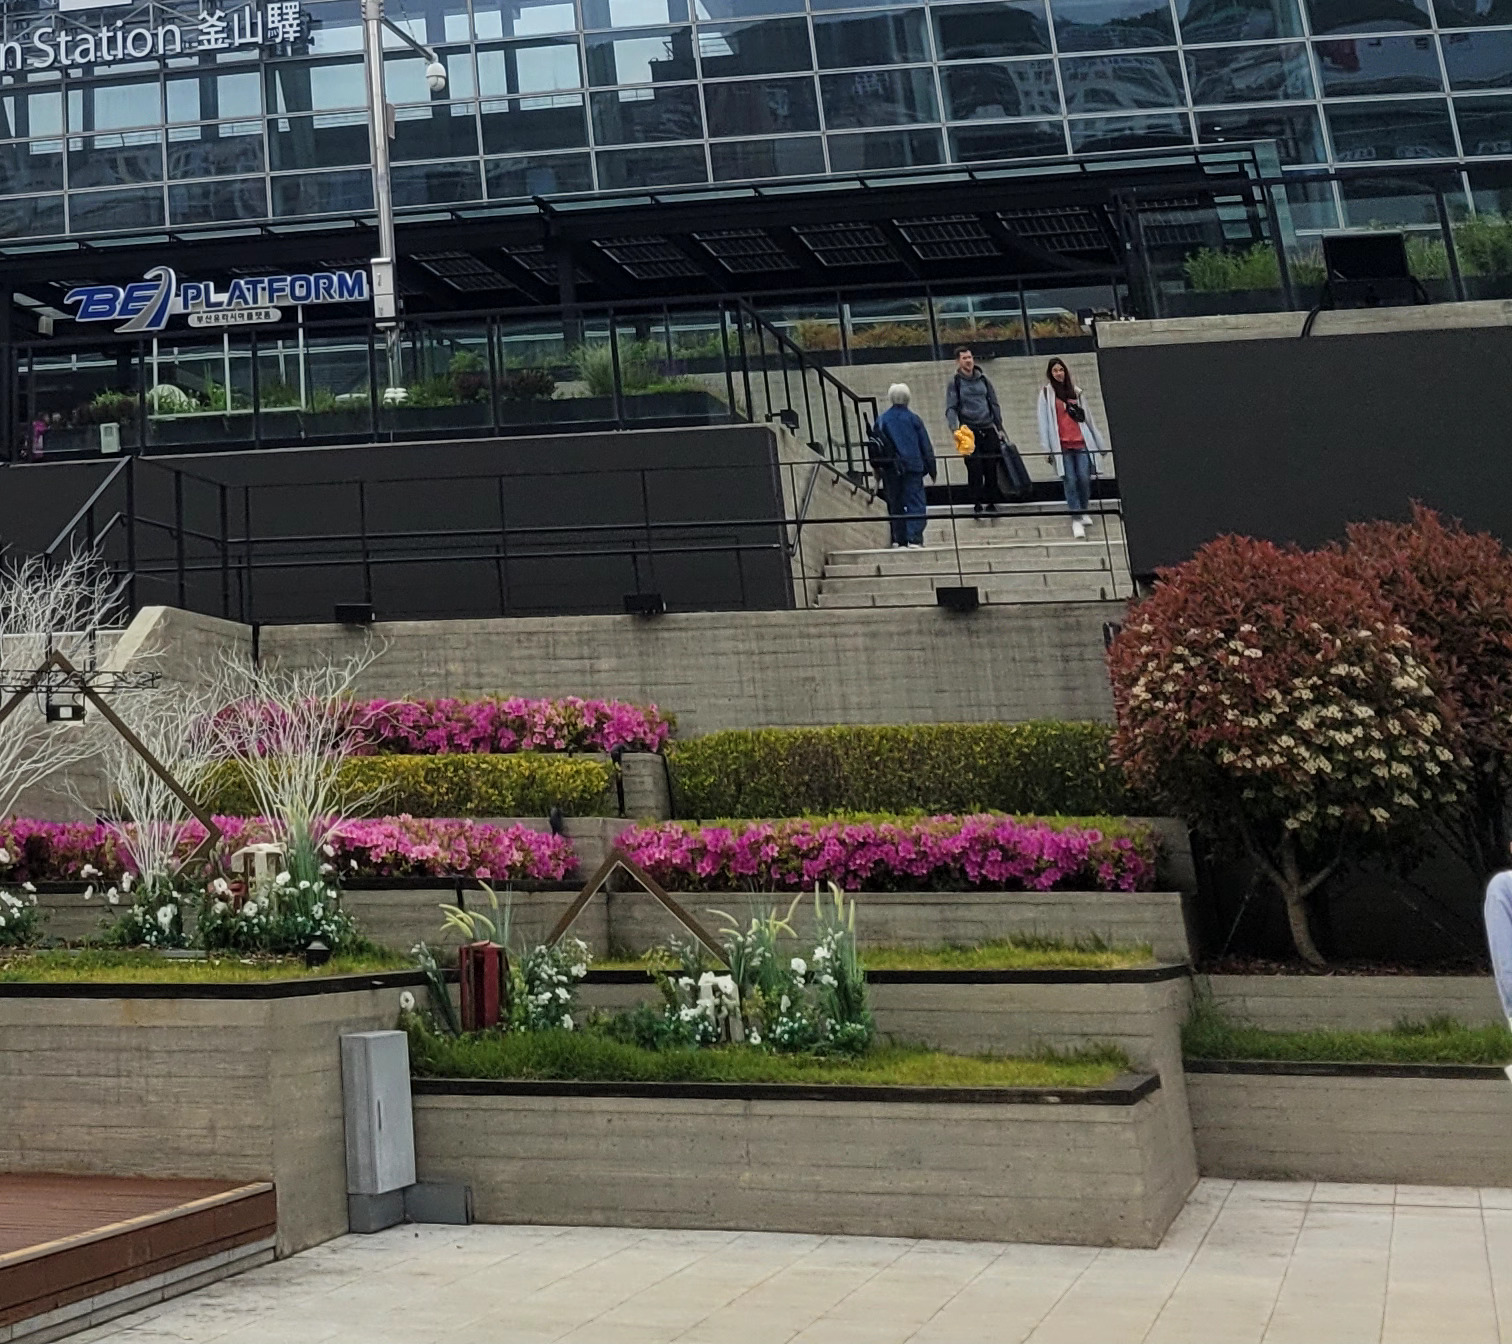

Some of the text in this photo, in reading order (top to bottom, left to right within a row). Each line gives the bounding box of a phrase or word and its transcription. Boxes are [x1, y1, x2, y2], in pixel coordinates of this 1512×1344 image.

[31, 18, 183, 69] Station
[196, 1, 301, 51] 釜山驛
[180, 269, 369, 311] PLATFORM
